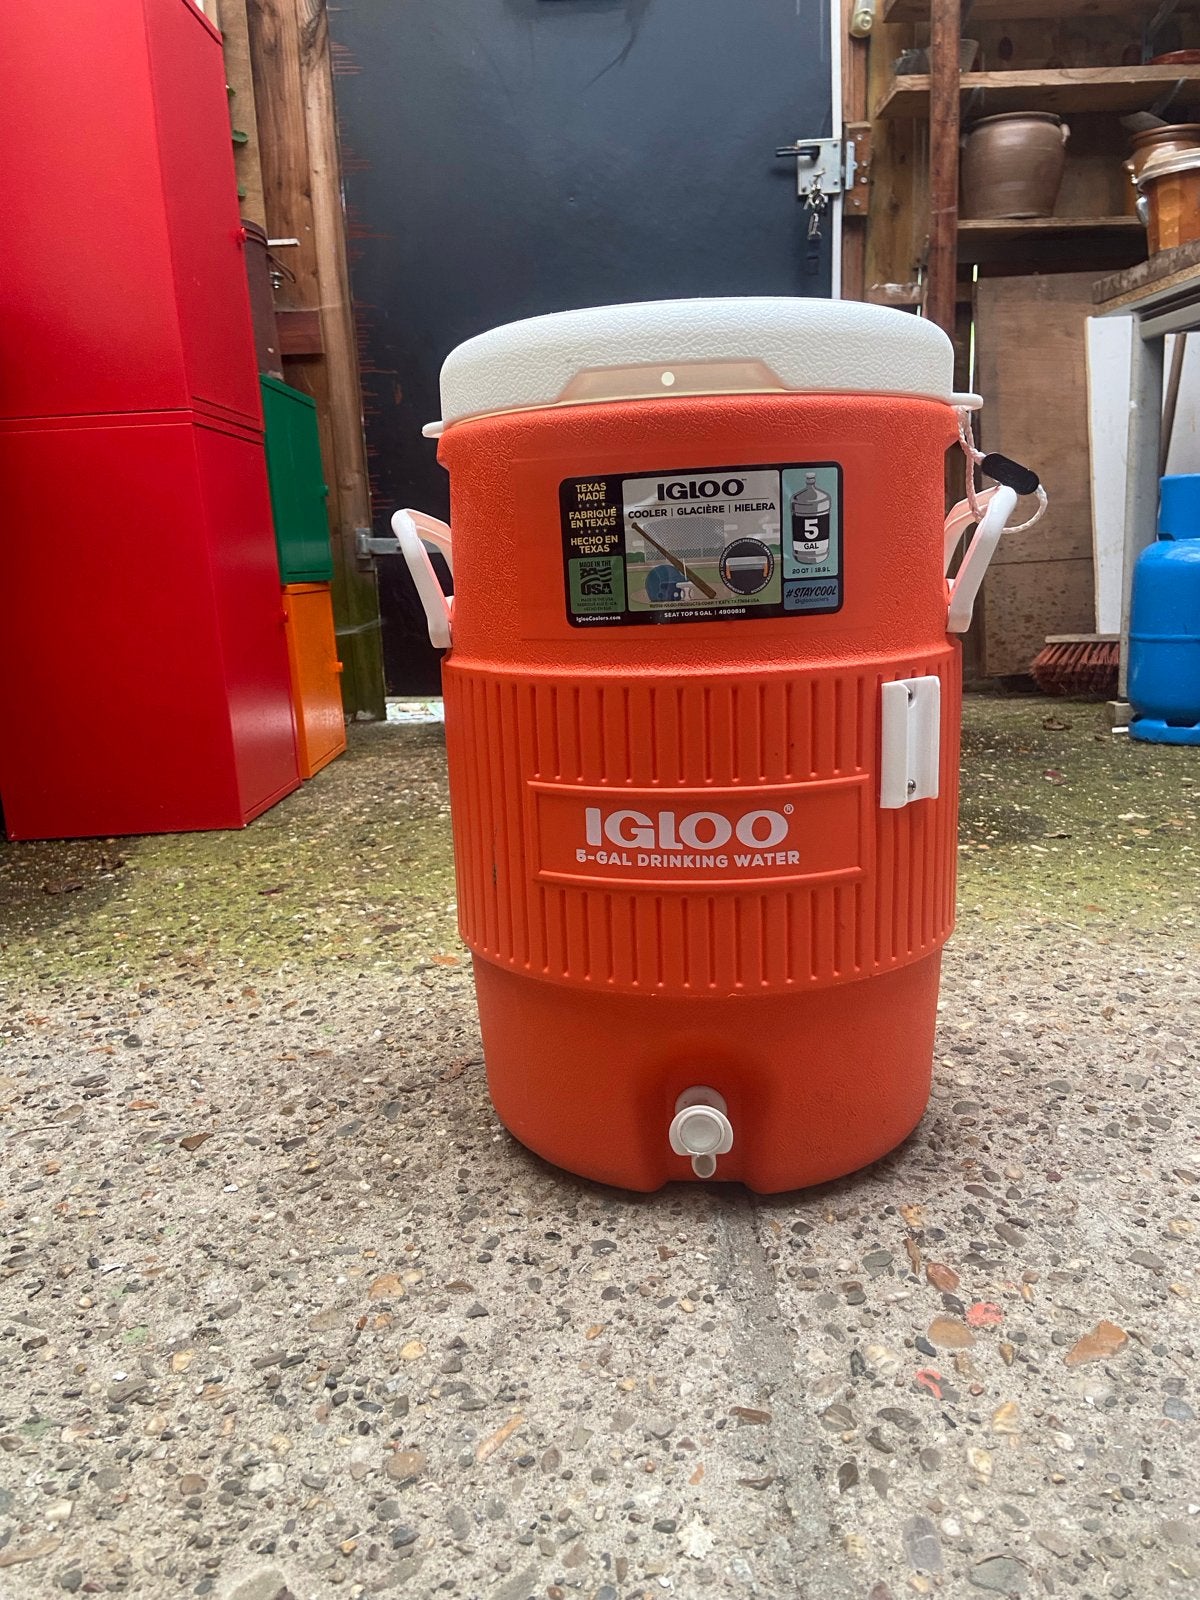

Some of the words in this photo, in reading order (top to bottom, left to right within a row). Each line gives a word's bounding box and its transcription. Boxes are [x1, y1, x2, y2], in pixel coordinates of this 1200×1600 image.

[575, 482, 607, 493] TEXAS
[577, 492, 606, 502] MADE
[568, 506, 617, 520] FABRIQUÉ
[628, 508, 668, 519] COOLER
[677, 504, 725, 516] GLACIÈRE
[734, 502, 776, 513] HIELERA
[570, 519, 584, 529] EN
[584, 517, 616, 528] TEXAS
[804, 518, 819, 540] 5
[570, 536, 604, 546] HECHO
[605, 535, 619, 544] EN
[803, 542, 820, 550] GAL
[579, 544, 610, 554] TEXAS
[580, 583, 613, 596] USA
[785, 585, 837, 599] #STAYCOOL
[575, 848, 632, 866] 5-GAL
[637, 853, 729, 868] DRINKING
[733, 850, 800, 868] WATER
